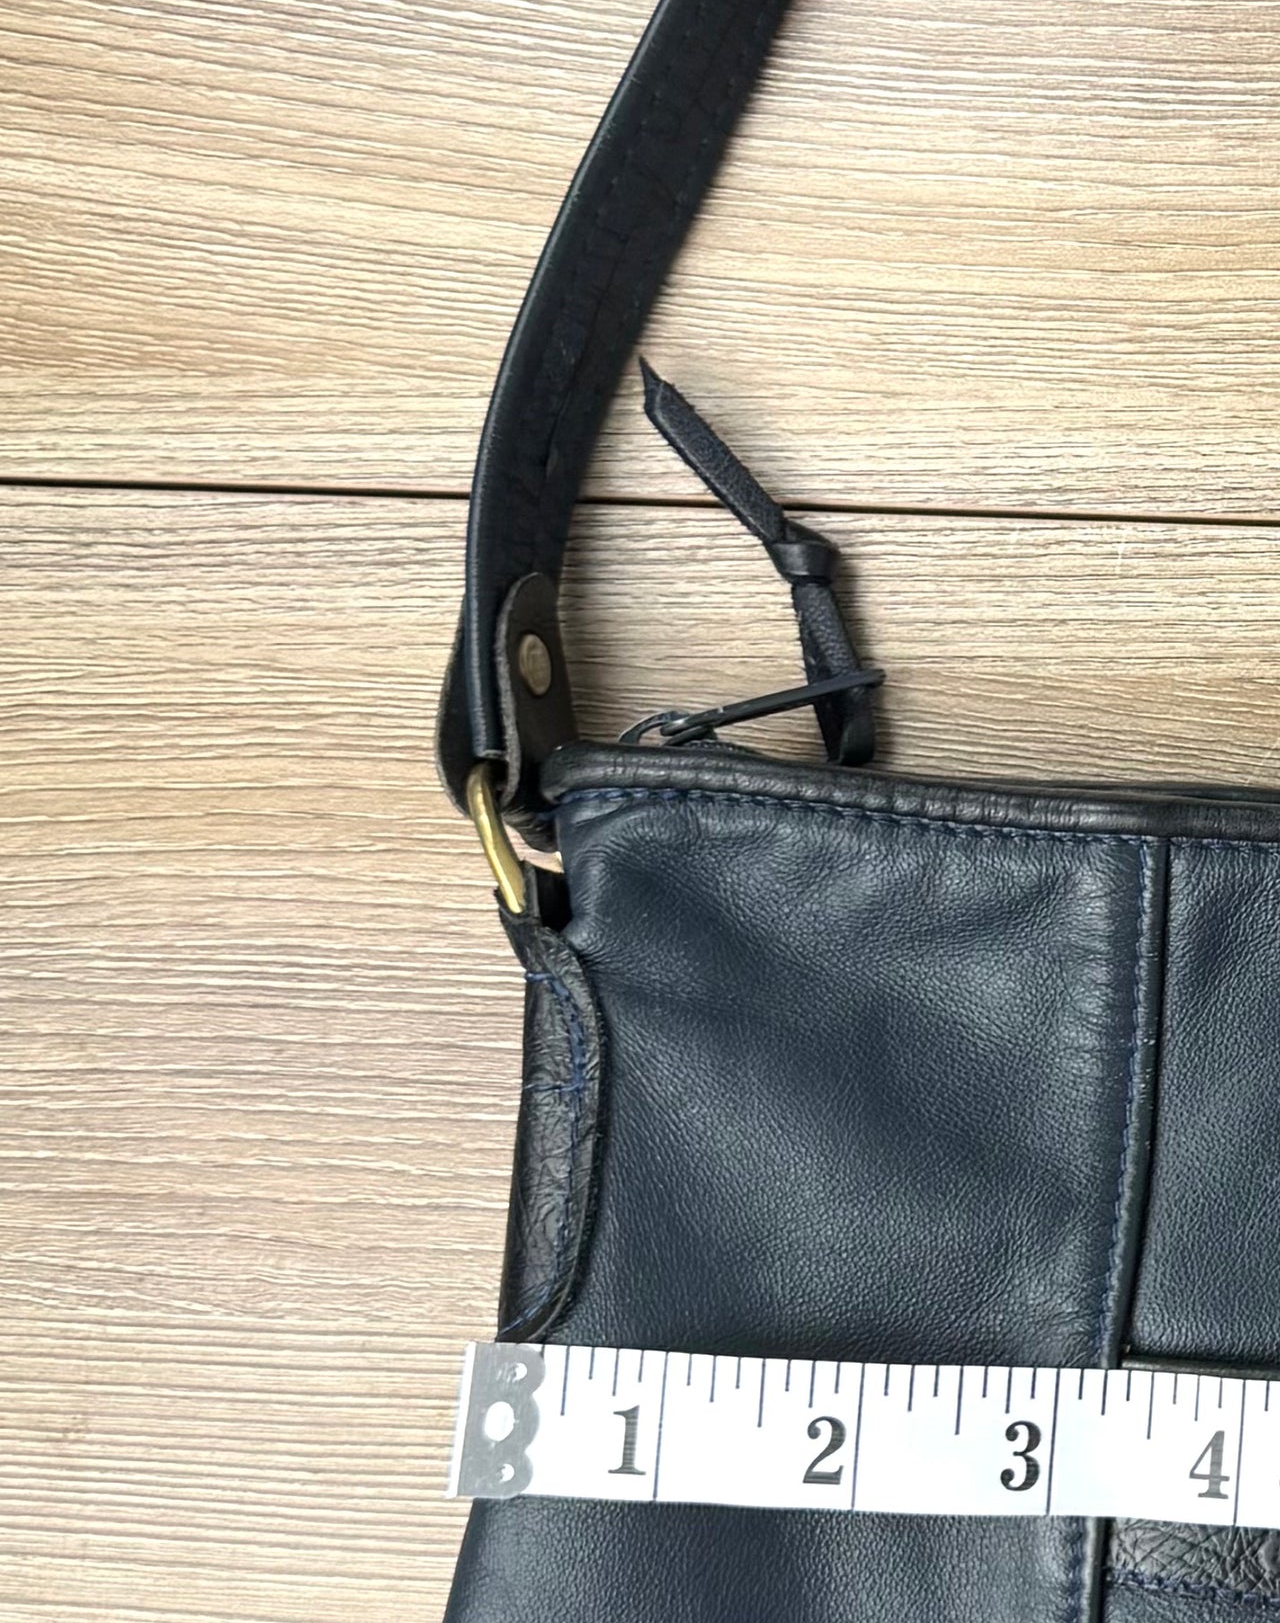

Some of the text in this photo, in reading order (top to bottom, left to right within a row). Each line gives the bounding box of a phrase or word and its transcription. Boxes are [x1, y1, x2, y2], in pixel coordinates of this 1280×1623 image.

[608, 1405, 647, 1477] 1
[803, 1416, 848, 1486] 2
[999, 1421, 1042, 1492] 3
[1188, 1430, 1230, 1500] 4
